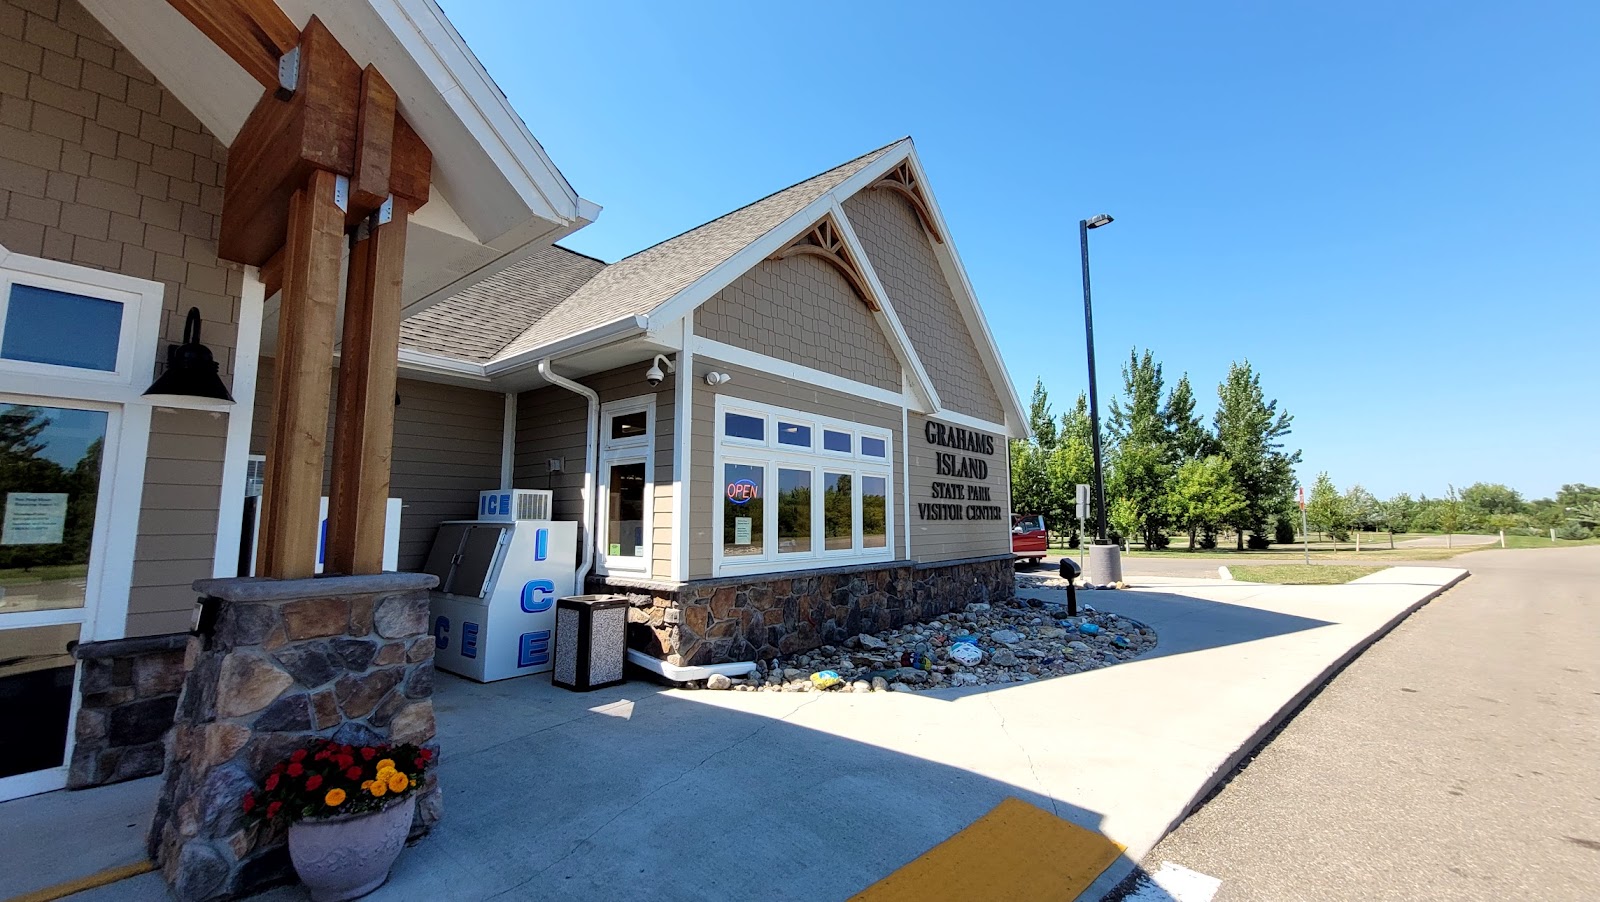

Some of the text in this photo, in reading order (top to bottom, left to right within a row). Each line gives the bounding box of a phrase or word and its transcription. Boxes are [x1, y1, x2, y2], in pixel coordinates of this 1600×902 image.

[925, 420, 994, 455] GRAHAMS
[936, 452, 988, 480] ISLAND
[727, 483, 758, 499] OPEN
[932, 482, 991, 501] STATE PARK
[481, 494, 511, 515] ICE
[918, 503, 1002, 520] VISITOR CENTER
[517, 528, 555, 668] ICE
[434, 615, 478, 659] CE
